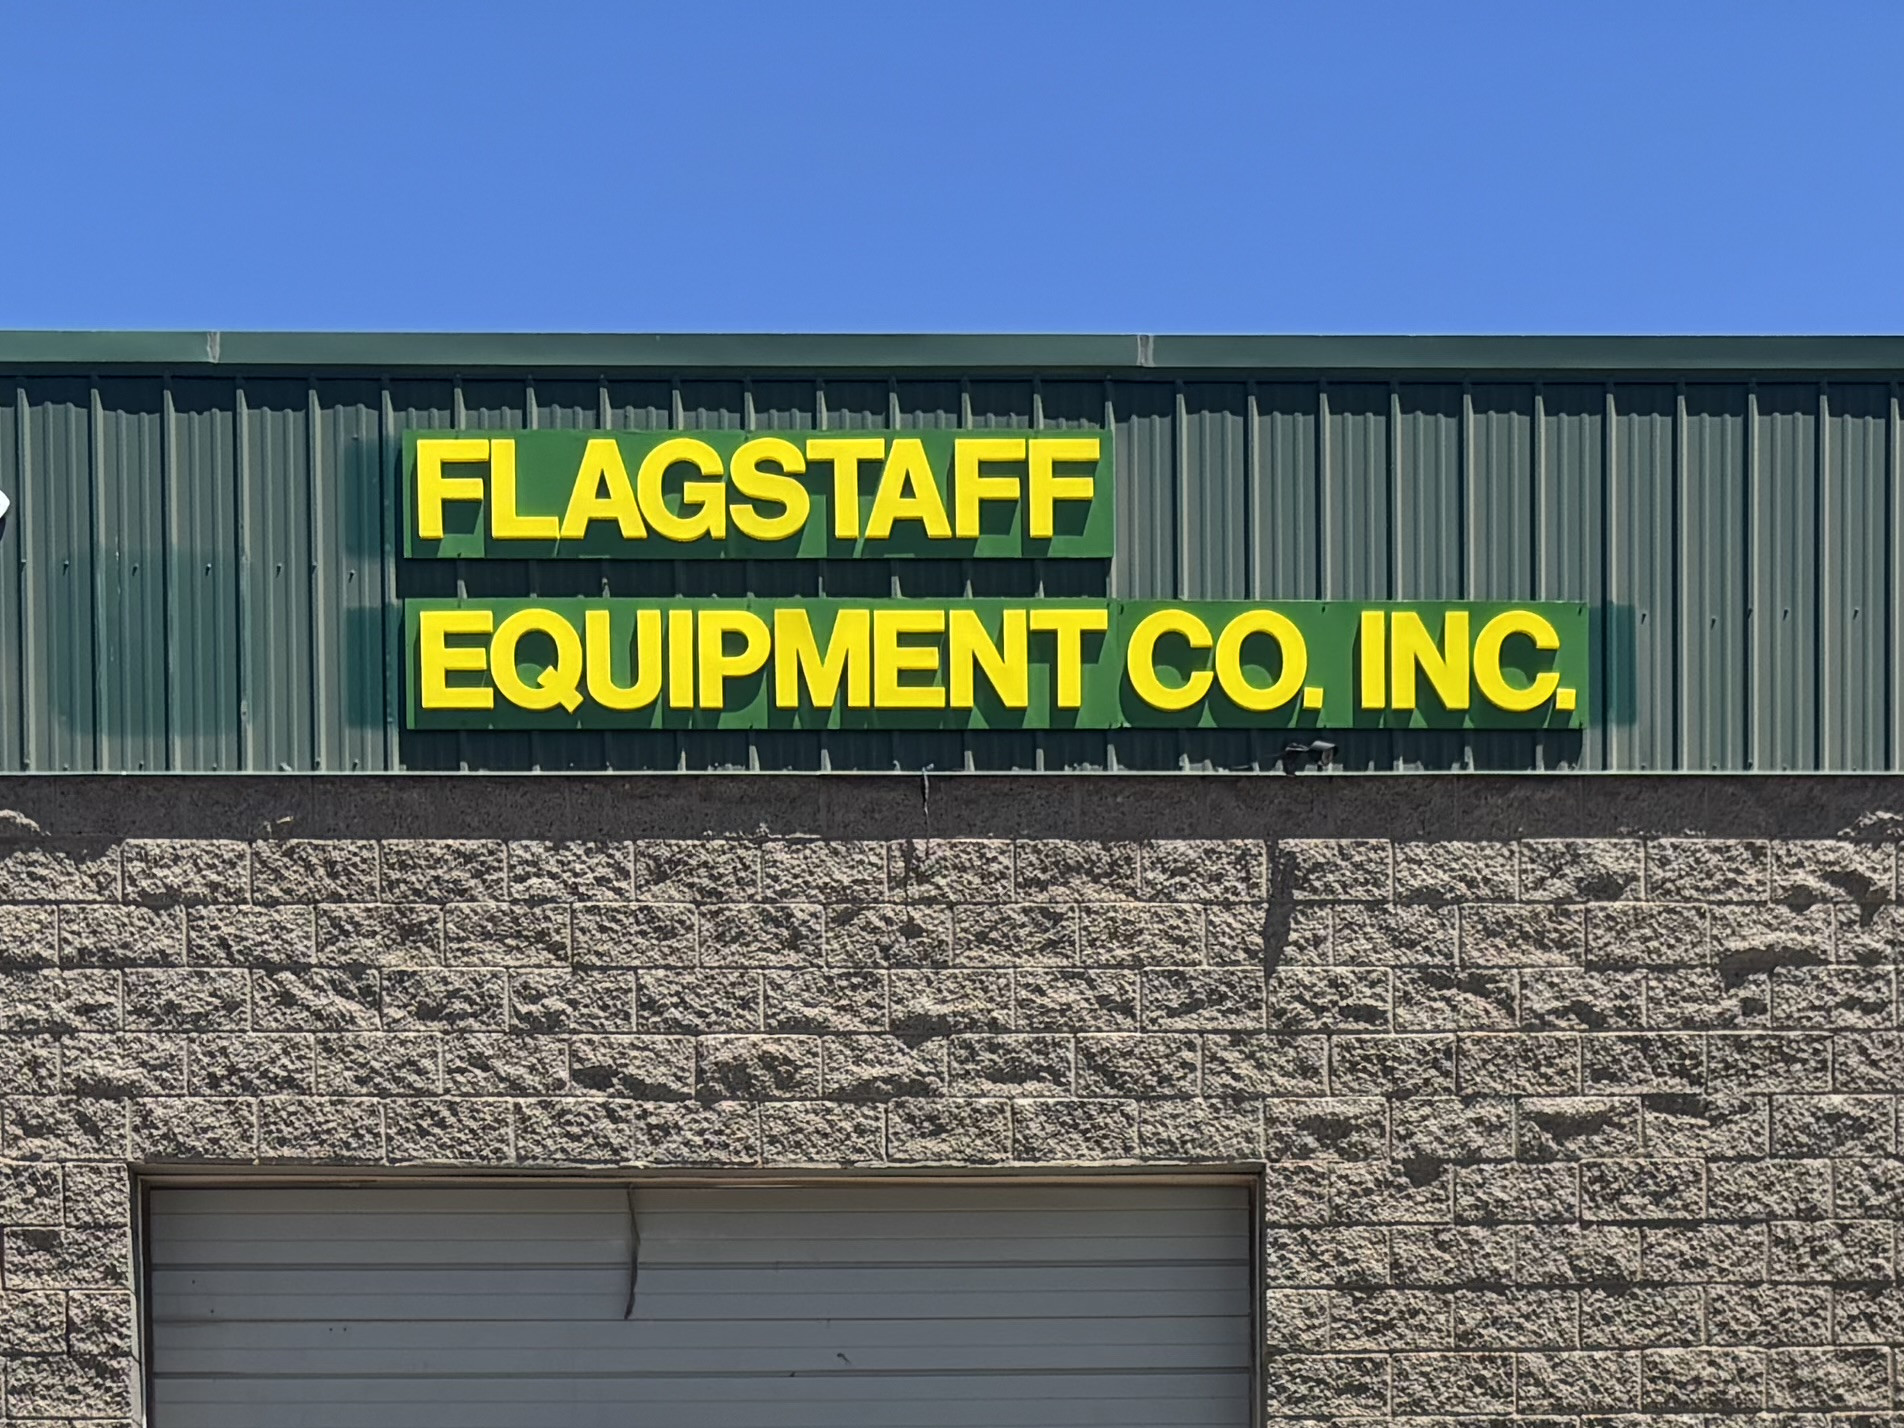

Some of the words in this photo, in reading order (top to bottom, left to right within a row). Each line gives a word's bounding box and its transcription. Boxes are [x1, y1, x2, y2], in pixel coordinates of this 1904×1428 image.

[417, 437, 1101, 542] FLAGSTAFF
[421, 608, 1109, 713] EQUIPMENT
[1128, 608, 1324, 711] CO.
[1361, 608, 1577, 711] INC.
